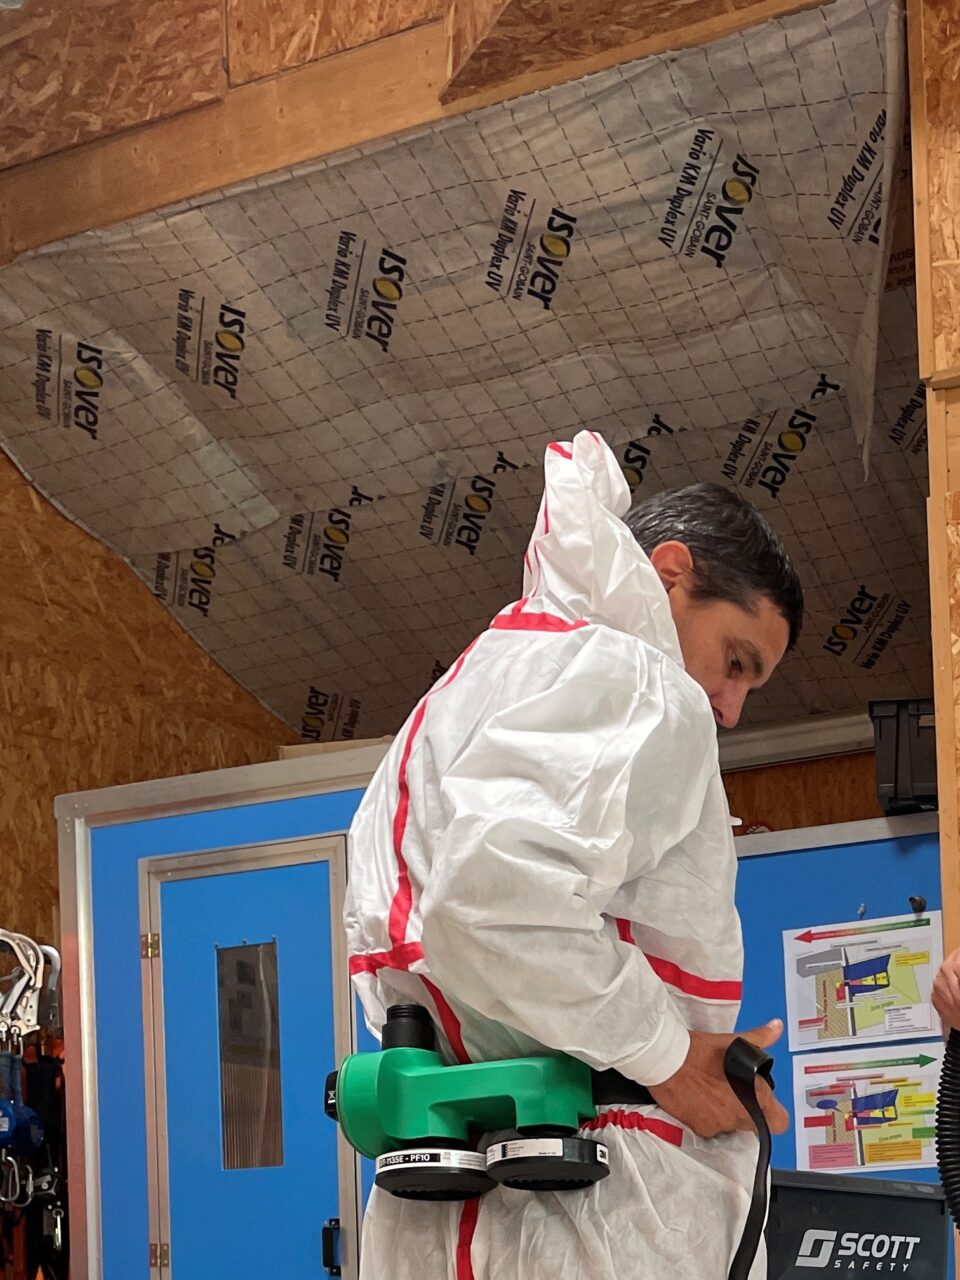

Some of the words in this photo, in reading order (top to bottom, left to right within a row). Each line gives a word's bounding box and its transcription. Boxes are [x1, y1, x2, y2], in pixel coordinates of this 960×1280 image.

[688, 128, 715, 160] Vario
[679, 162, 701, 187] KM
[504, 189, 527, 216] Vario
[664, 186, 693, 227] Duplex
[826, 206, 847, 231] UV
[657, 226, 678, 249] UV
[489, 232, 514, 271] Duplex
[484, 270, 503, 292] UV
[325, 313, 341, 332] UV
[411, 1153, 430, 1162] PF10
[837, 1232, 921, 1260] SCOTT
[834, 1259, 909, 1272] SAFETY
